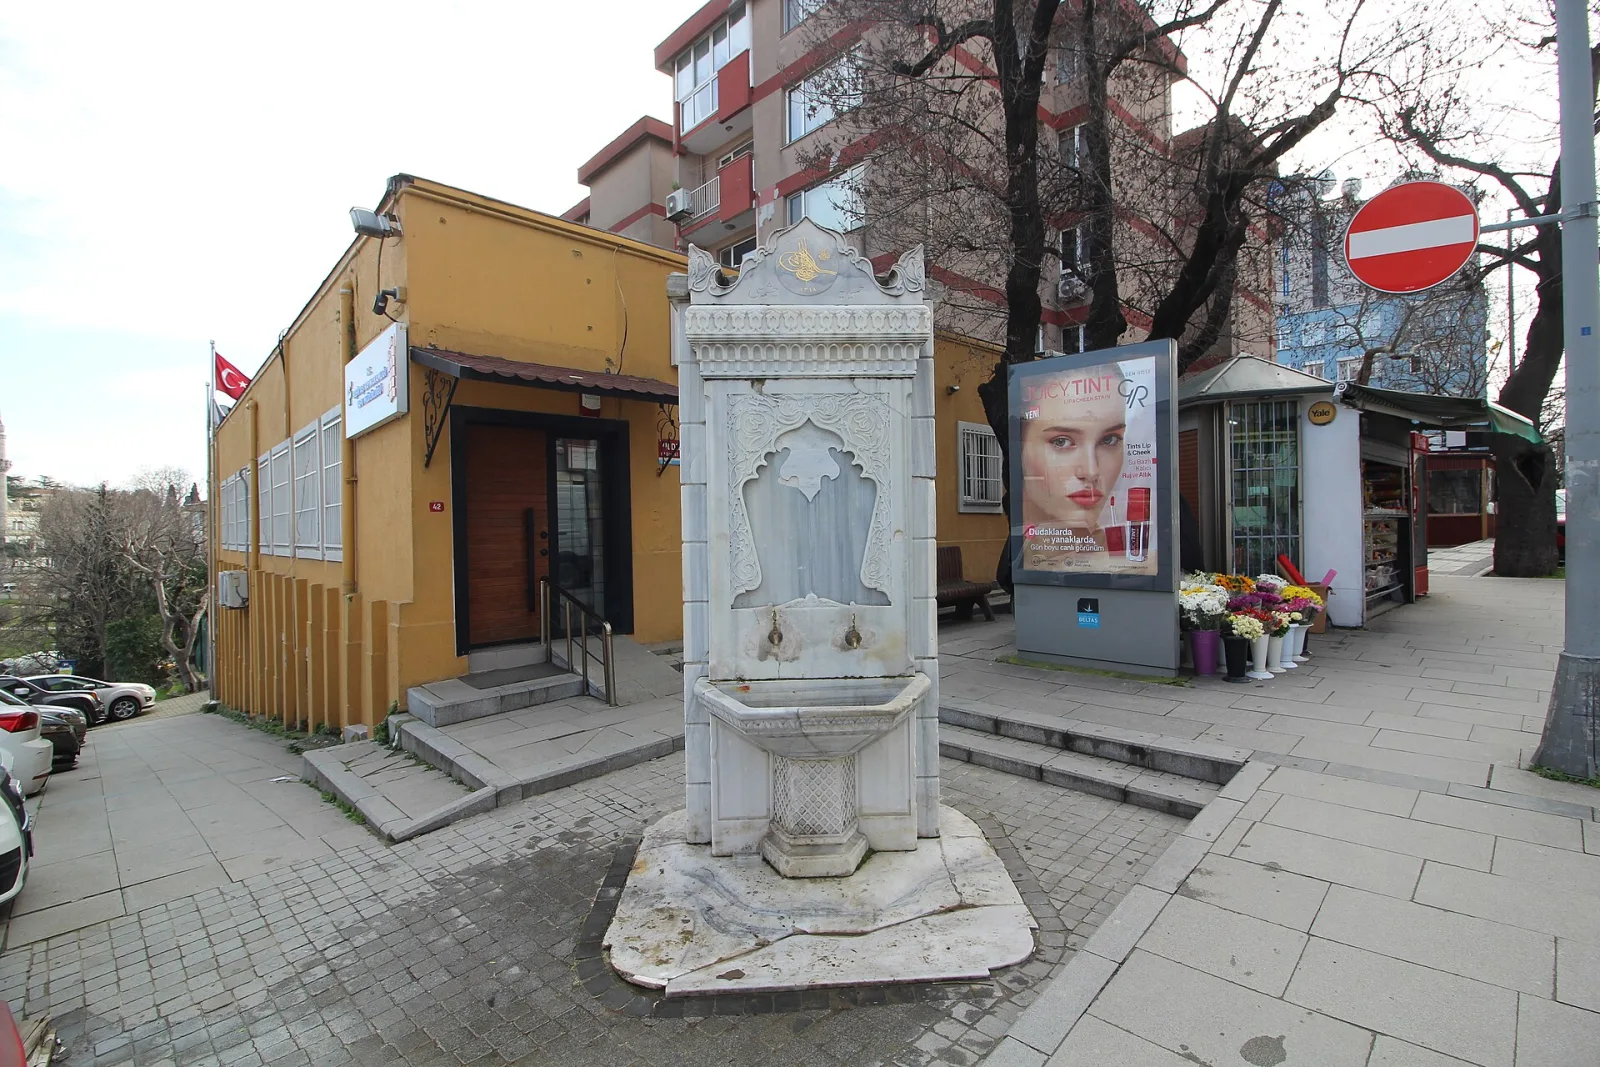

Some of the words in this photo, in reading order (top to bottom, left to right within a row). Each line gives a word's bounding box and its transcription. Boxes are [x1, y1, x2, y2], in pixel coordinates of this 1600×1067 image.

[1311, 409, 1331, 417] Yale
[1029, 527, 1073, 536] Dudaklarda
[1051, 535, 1096, 544] yanaklarda,
[1044, 544, 1060, 552] boyu
[1075, 544, 1105, 553] görünüm
